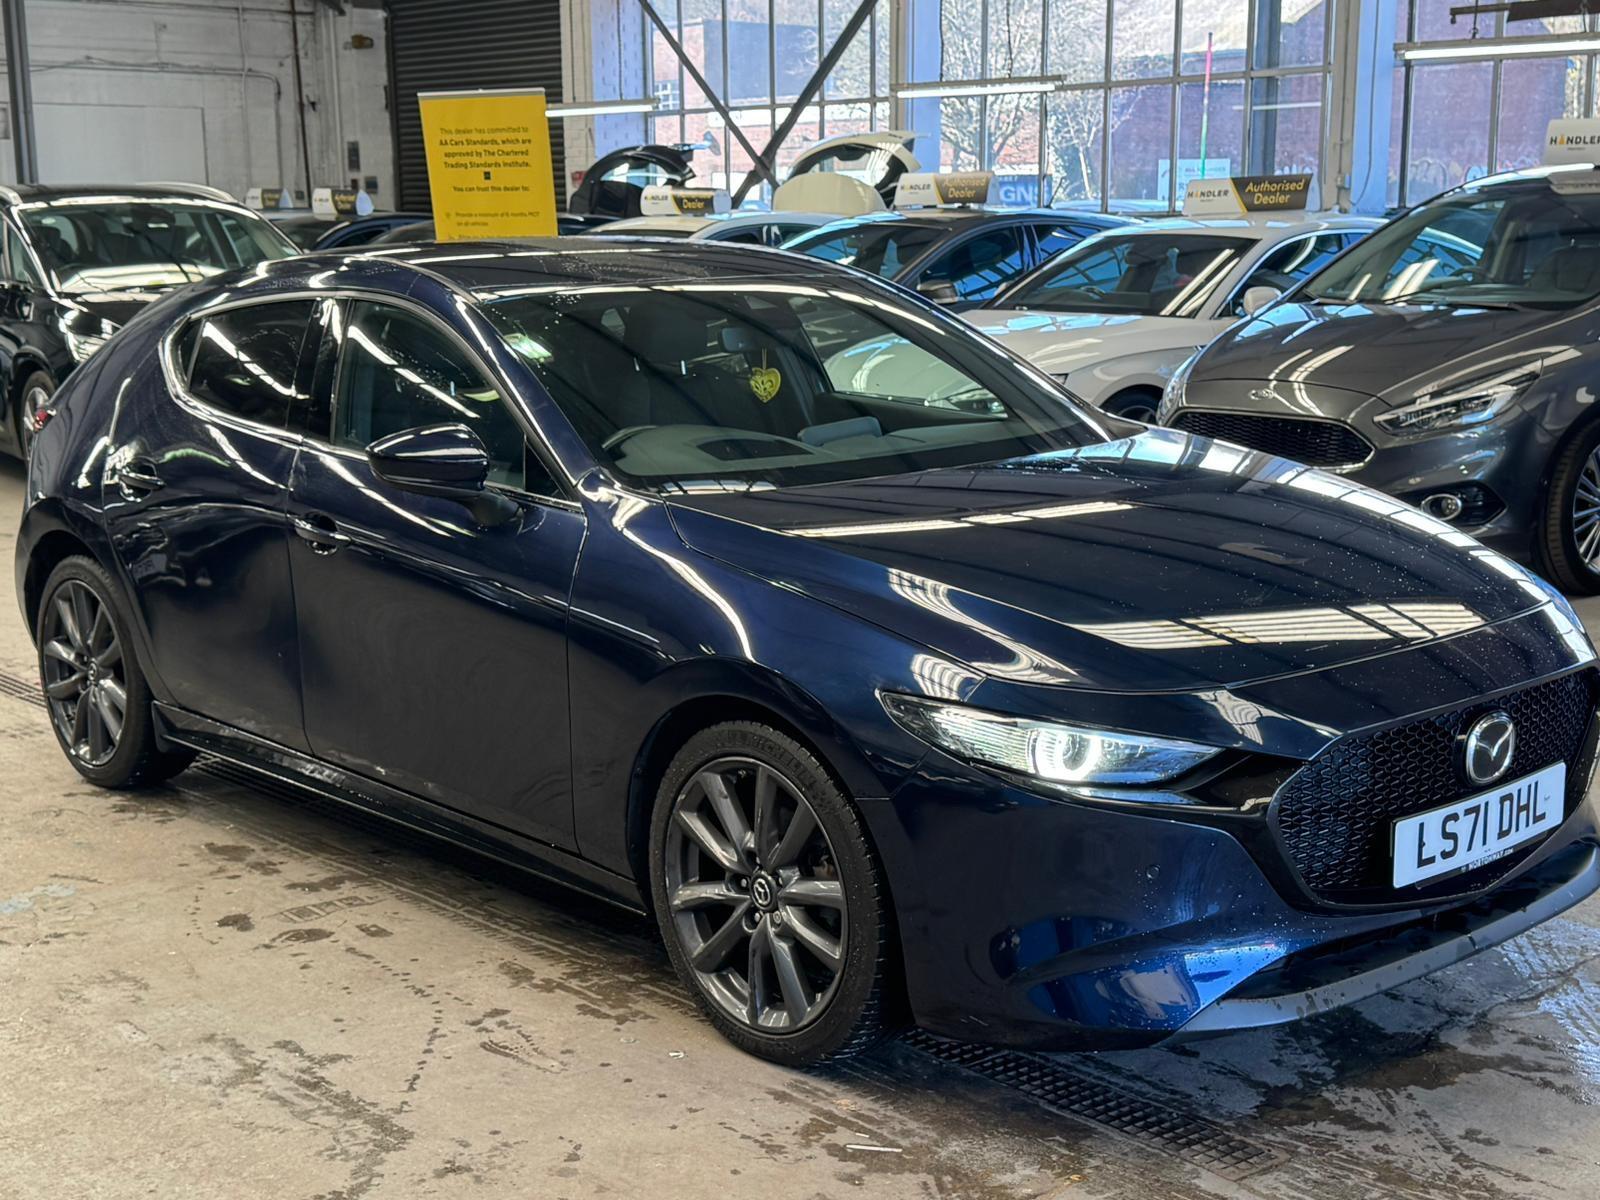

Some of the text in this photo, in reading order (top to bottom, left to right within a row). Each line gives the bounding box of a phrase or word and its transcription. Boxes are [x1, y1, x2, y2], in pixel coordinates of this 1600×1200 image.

[487, 126, 520, 134] committed
[465, 138, 501, 146] Standards,
[501, 137, 520, 145] which
[444, 150, 474, 158] approved
[475, 150, 482, 158] by
[497, 149, 529, 157] Chartered
[444, 161, 468, 169] Trading
[1245, 179, 1306, 193] Authorised
[948, 187, 976, 198] Dealer
[682, 198, 704, 209] Dealer
[1254, 192, 1291, 205] Dealer
[1417, 780, 1546, 868] LS71 DHL
